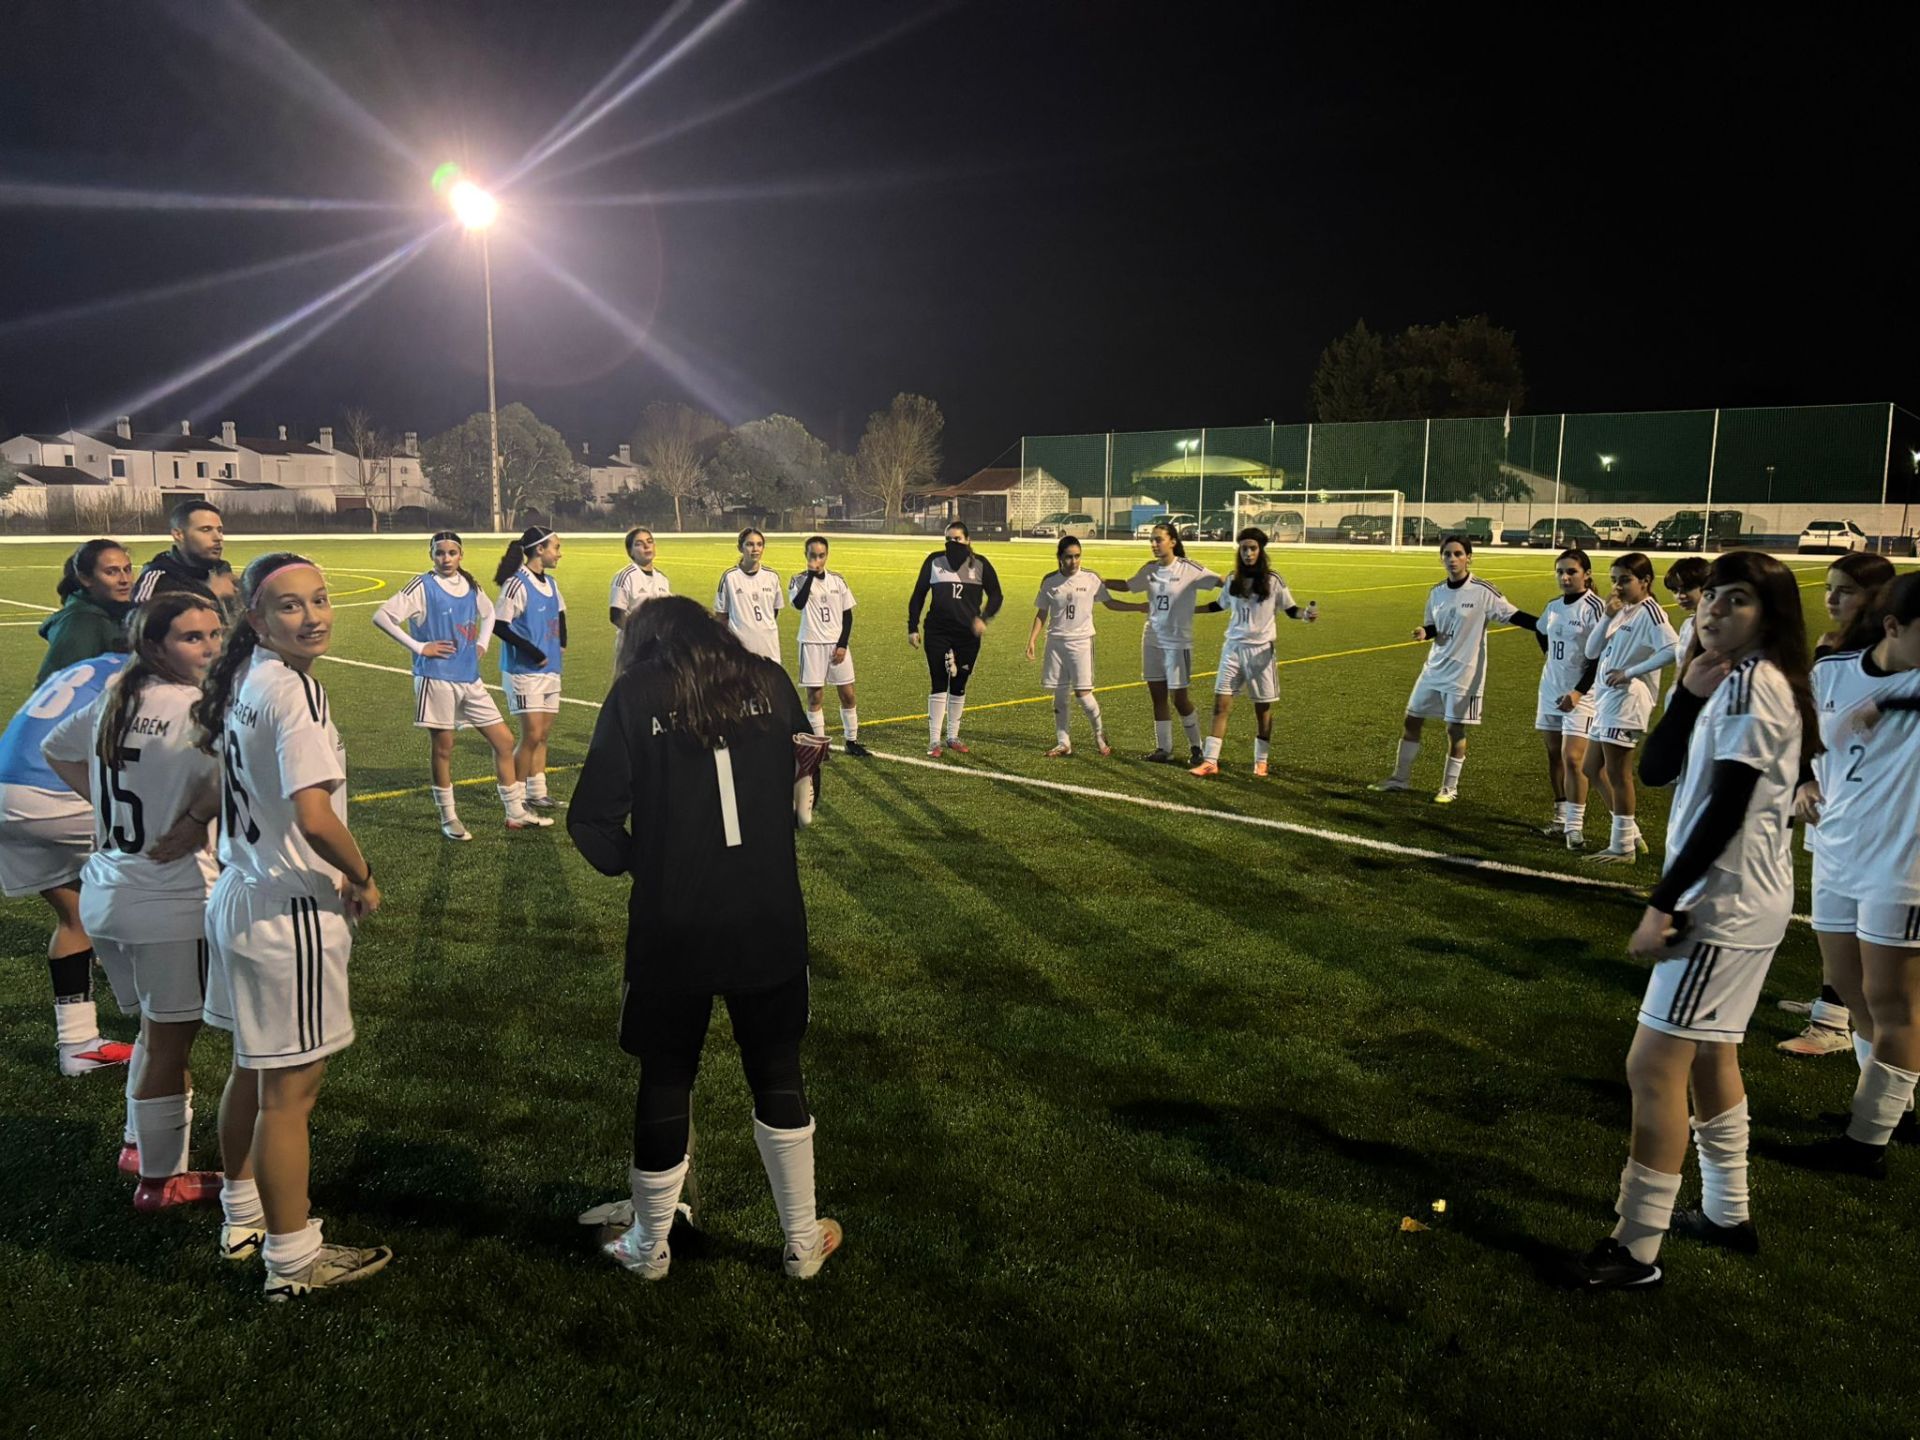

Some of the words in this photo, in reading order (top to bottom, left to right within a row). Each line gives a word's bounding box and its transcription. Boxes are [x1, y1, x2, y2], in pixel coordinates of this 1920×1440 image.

[952, 583, 963, 599] 12
[1065, 604, 1076, 620] 19
[1157, 595, 1169, 611] 23
[754, 607, 762, 622] 6
[819, 607, 829, 623] 13
[1552, 640, 1565, 660] 18
[129, 715, 170, 738] ARÉM
[1845, 744, 1865, 782] 2
[97, 746, 144, 855] 15
[713, 736, 742, 848] 1
